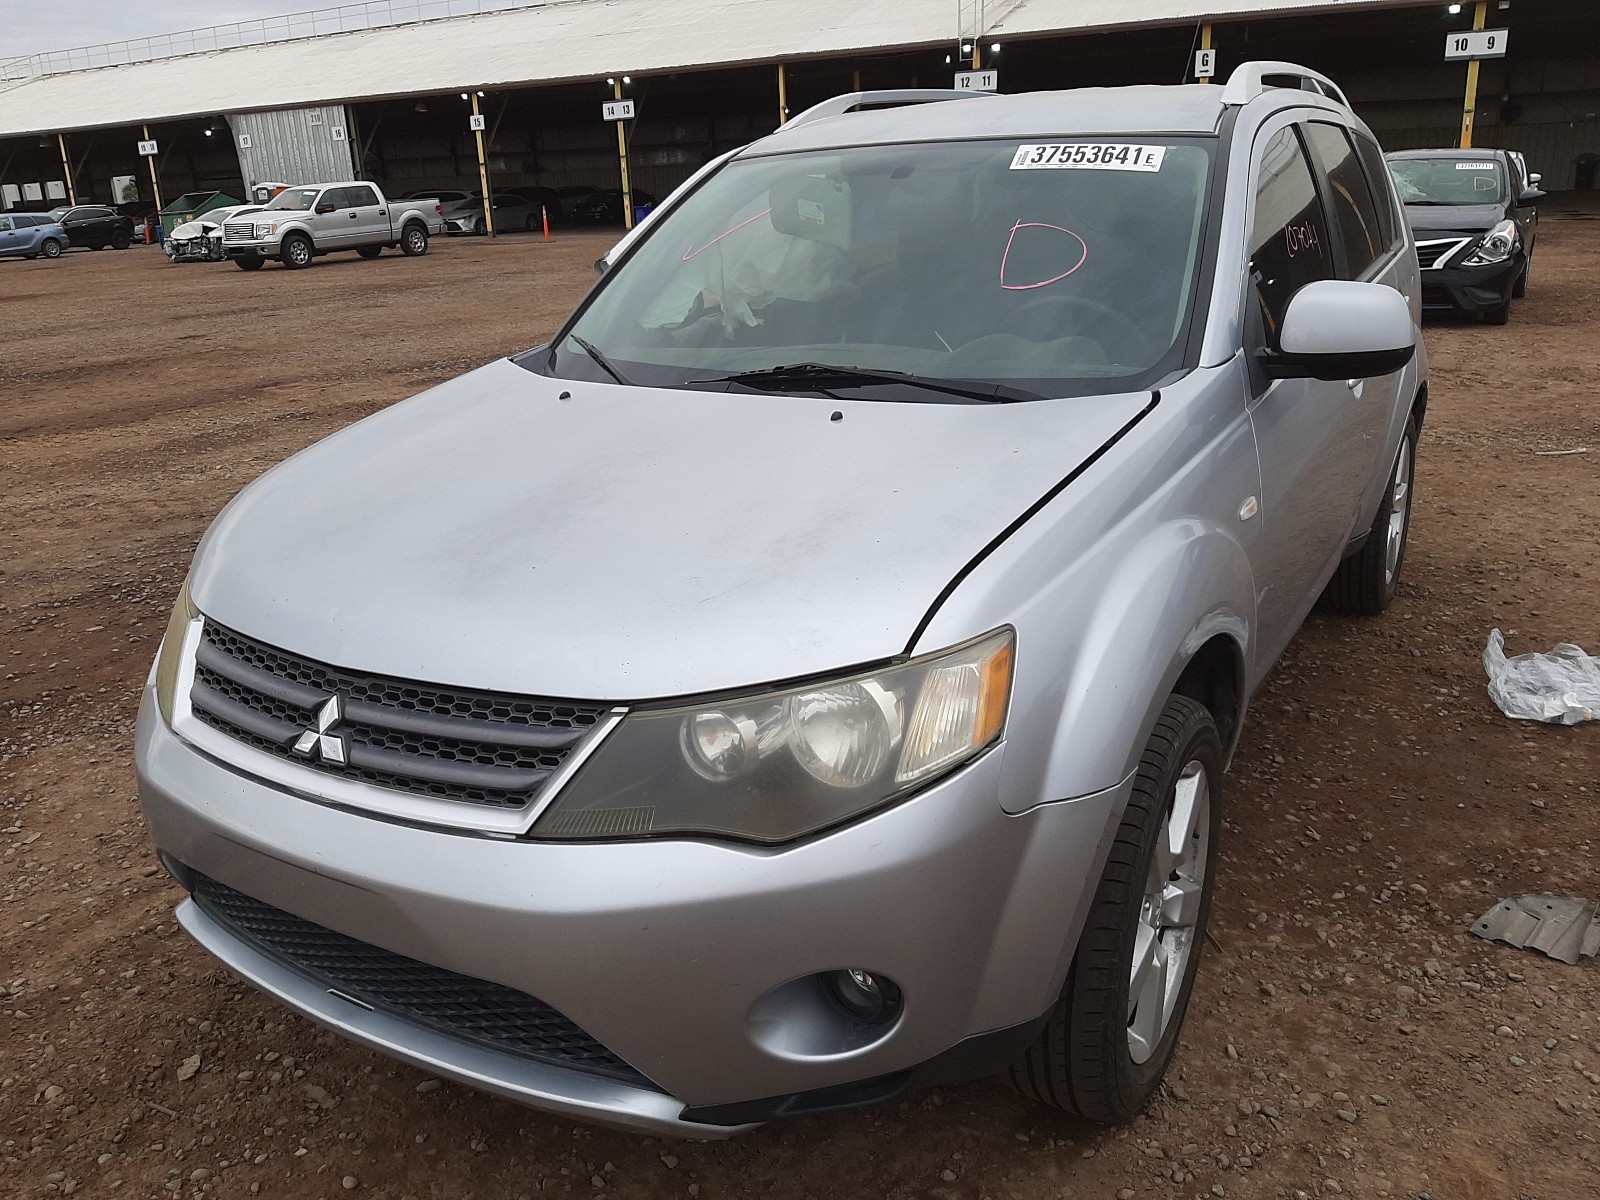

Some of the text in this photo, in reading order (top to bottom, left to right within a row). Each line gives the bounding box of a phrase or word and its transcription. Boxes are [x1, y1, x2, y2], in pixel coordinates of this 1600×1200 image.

[1454, 35, 1496, 52] 10 9
[1202, 53, 1210, 67] G
[961, 75, 991, 88] 12 11
[607, 104, 630, 116] 14 13
[473, 117, 481, 128] 15
[1030, 145, 1144, 166] 37553641
[1145, 153, 1156, 165] E
[1000, 218, 1088, 290] D
